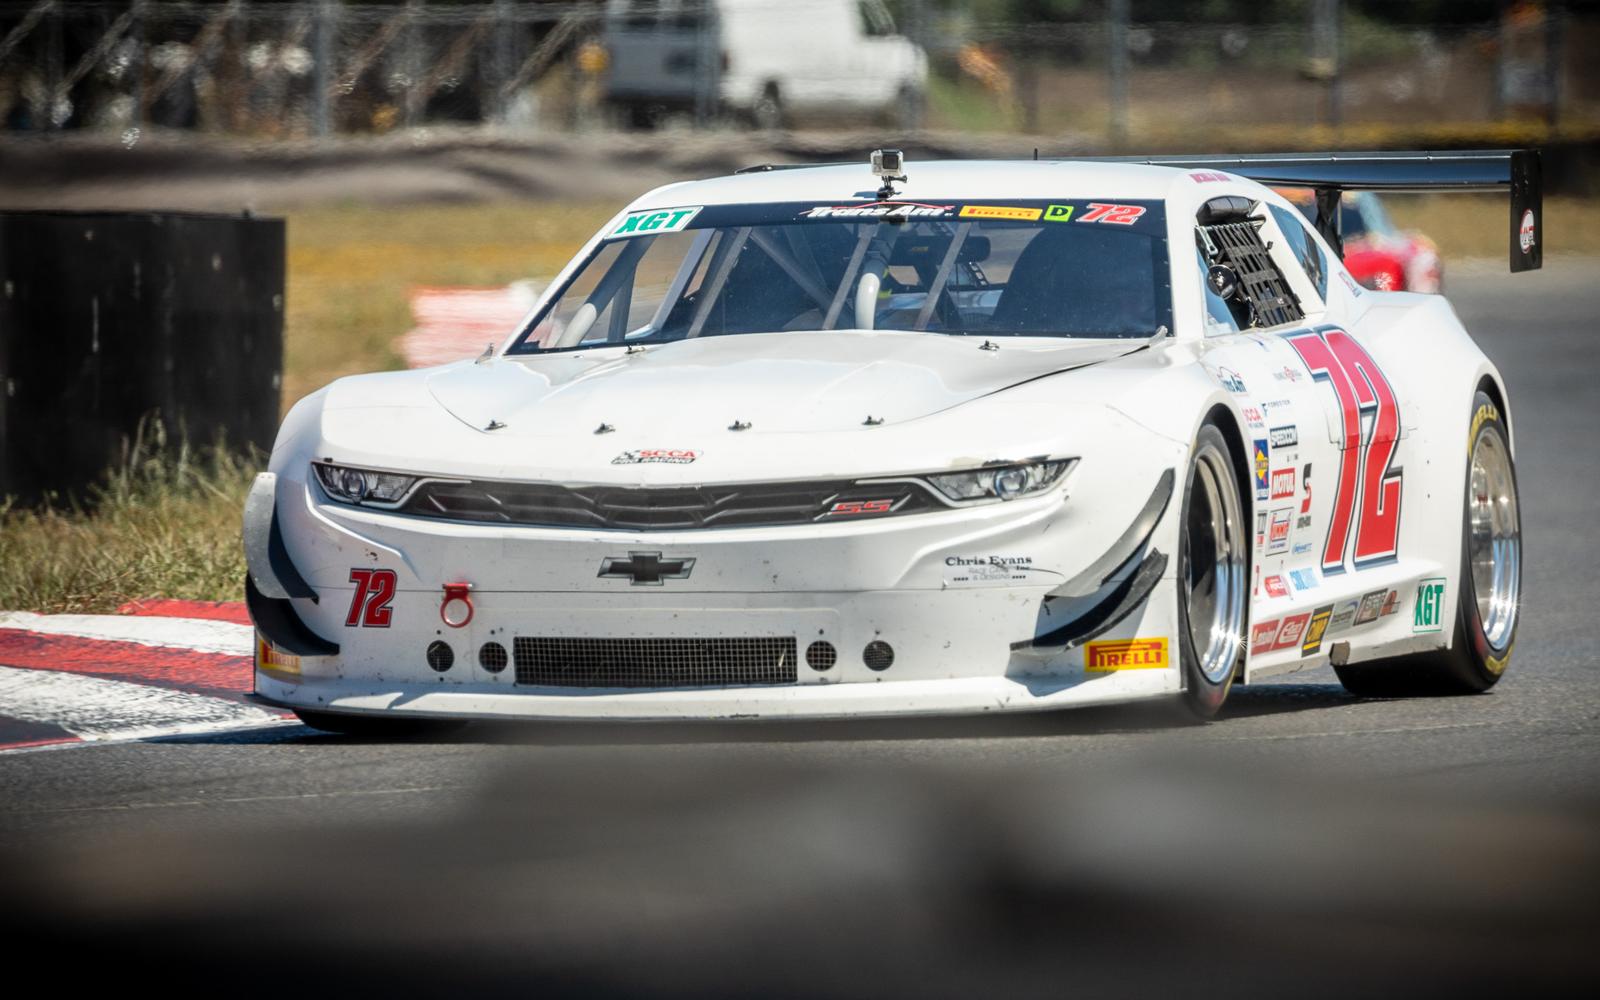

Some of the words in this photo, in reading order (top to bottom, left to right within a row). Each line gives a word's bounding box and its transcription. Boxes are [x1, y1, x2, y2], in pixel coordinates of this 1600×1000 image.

[613, 210, 693, 234] XGT
[807, 205, 890, 218] Trans
[885, 204, 946, 217] Am
[1076, 202, 1147, 225] 72
[640, 448, 697, 459] SCCA
[1276, 323, 1404, 577] 72
[1272, 471, 1296, 497] MOTUL
[830, 498, 894, 515] SS
[944, 555, 987, 567] Chris
[988, 555, 1033, 566] Evans
[345, 568, 398, 628] 72
[1414, 584, 1446, 626] XGT
[1088, 641, 1163, 668] PIRELLI
